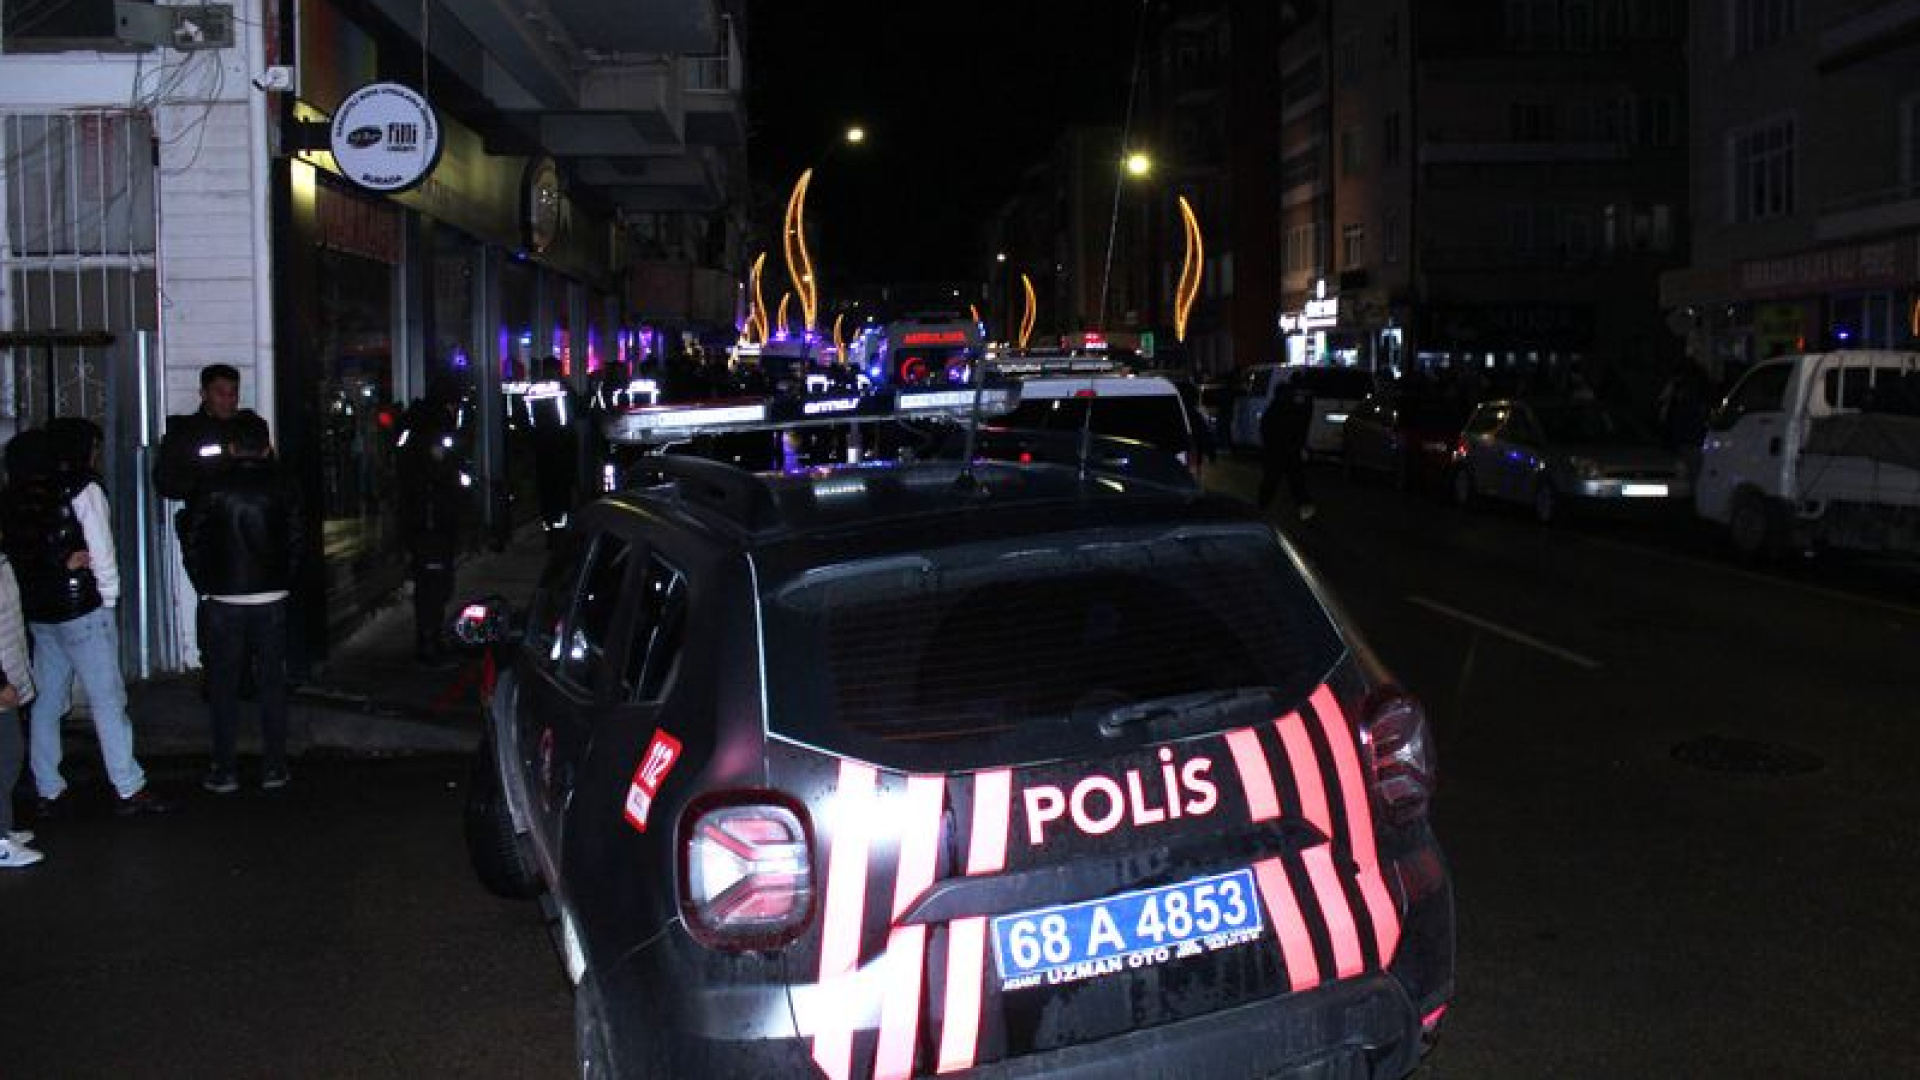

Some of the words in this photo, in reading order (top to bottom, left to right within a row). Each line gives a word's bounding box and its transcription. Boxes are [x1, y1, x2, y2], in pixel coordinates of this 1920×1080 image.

[641, 741, 673, 787] 112
[1023, 746, 1218, 846] POLİS
[1010, 914, 1070, 968] 68
[1086, 906, 1127, 956] A
[1136, 880, 1248, 942] 4853
[1047, 956, 1123, 984] UZMAN
[1128, 946, 1169, 968] OTO
